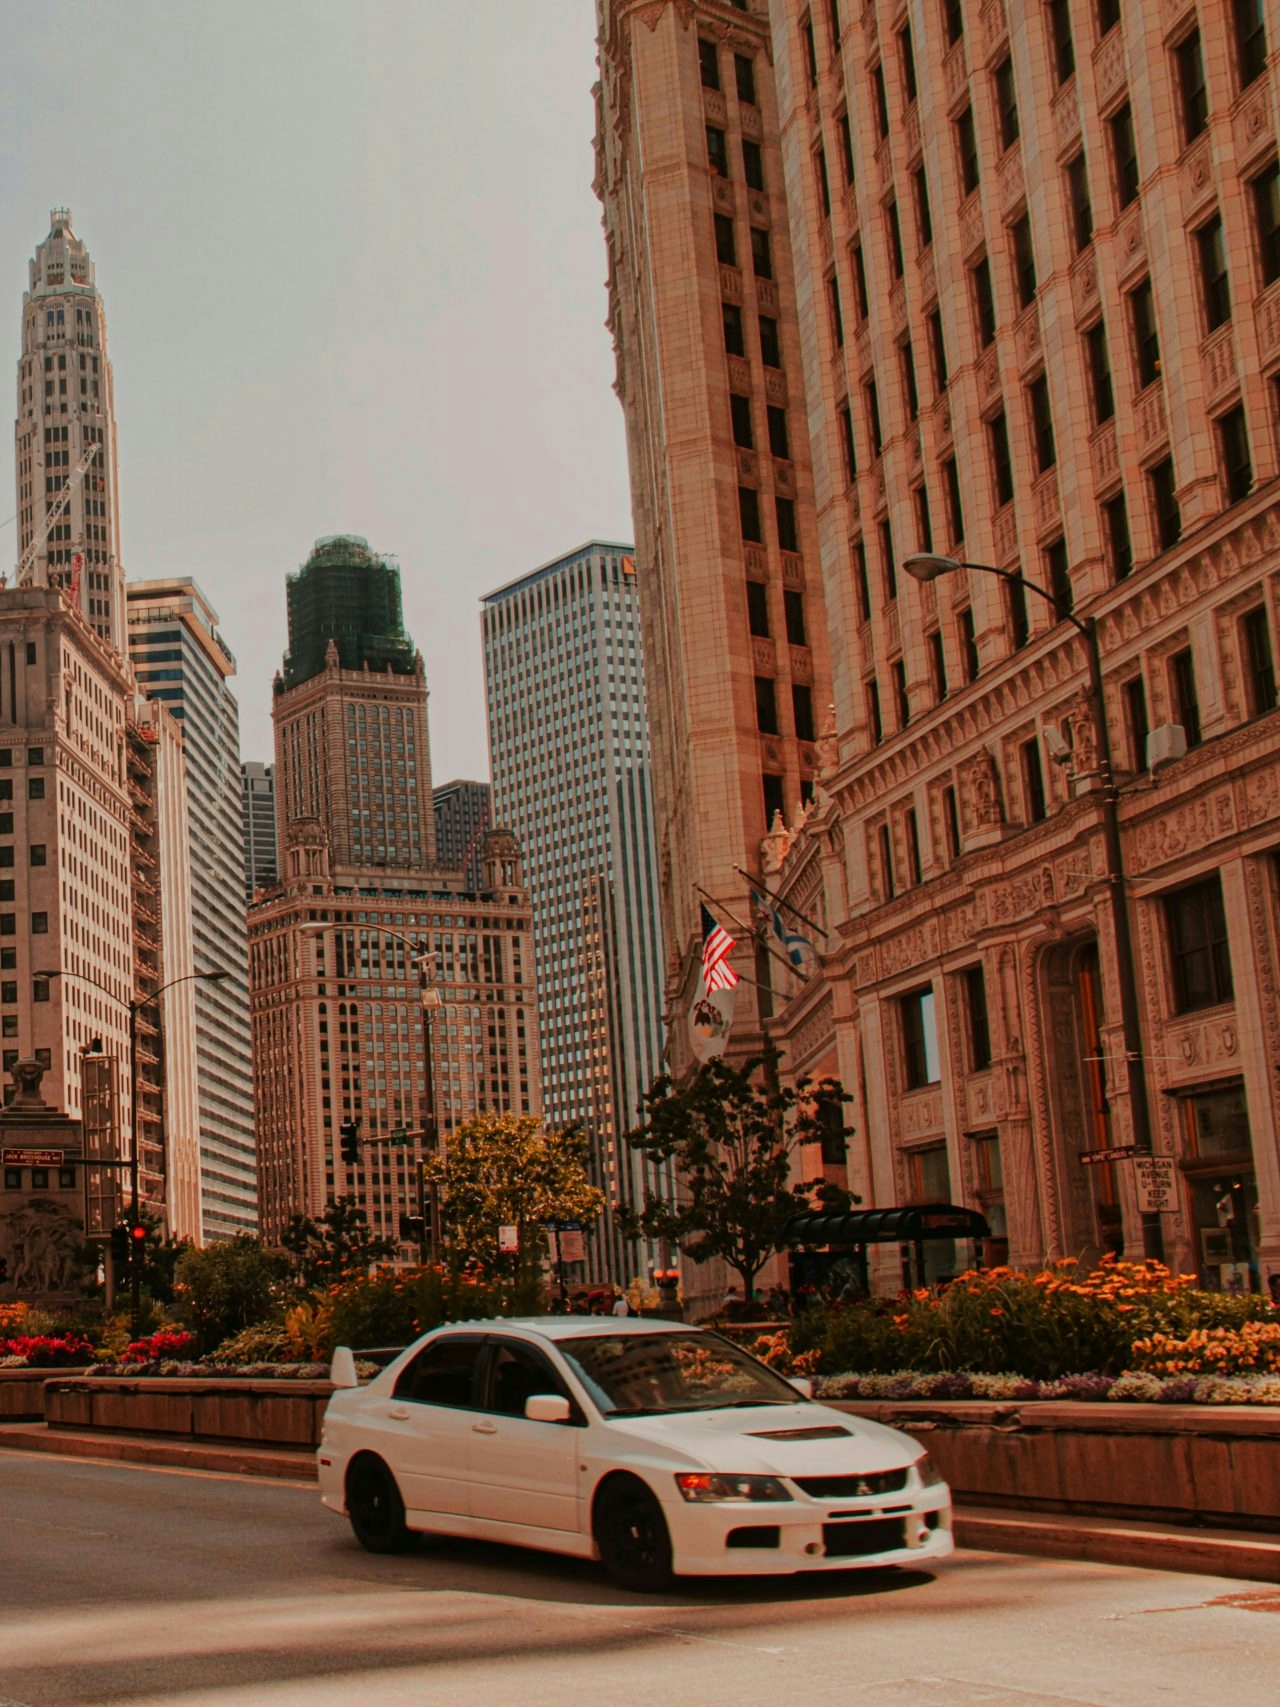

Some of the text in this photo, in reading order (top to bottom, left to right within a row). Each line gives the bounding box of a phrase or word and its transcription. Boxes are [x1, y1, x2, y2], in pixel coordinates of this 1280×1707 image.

[1136, 1160, 1172, 1170] MICHIGAN
[1141, 1170, 1170, 1180] AVENUE
[1141, 1180, 1172, 1189] U-TURN
[1147, 1189, 1167, 1199] KEEP
[1147, 1199, 1169, 1209] RIGHT
